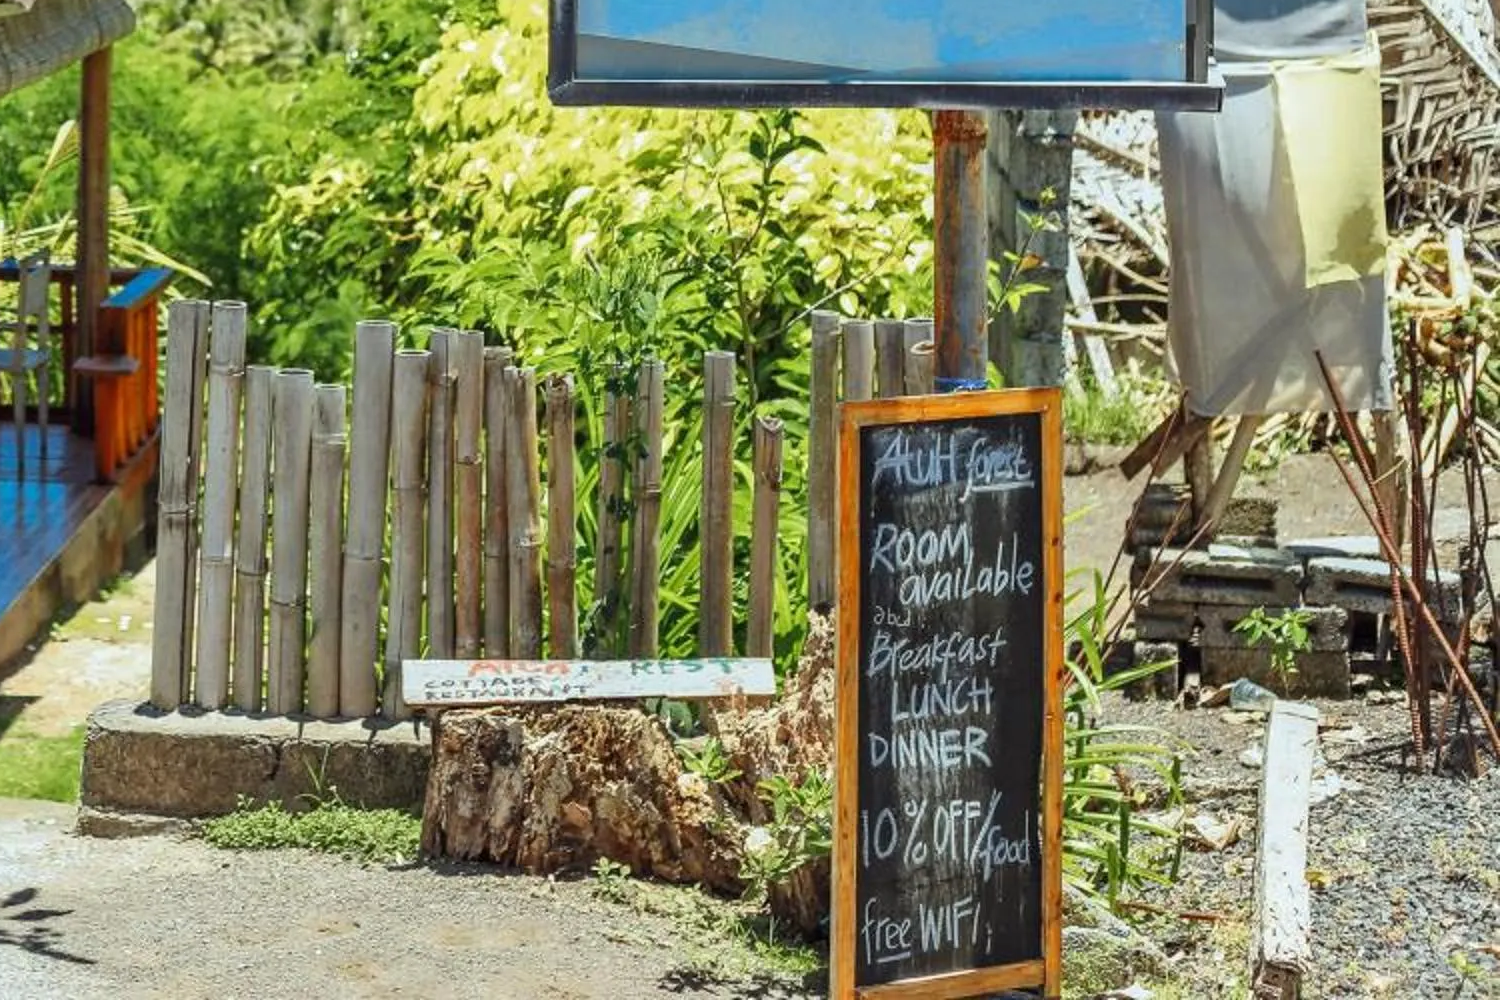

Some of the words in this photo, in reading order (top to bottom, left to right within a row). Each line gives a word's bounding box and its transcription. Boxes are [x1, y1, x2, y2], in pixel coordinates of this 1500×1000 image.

[867, 627, 1008, 684] Breakfast
[890, 676, 993, 722] LUNCH
[868, 726, 993, 771] DINNER
[861, 897, 911, 965] free
